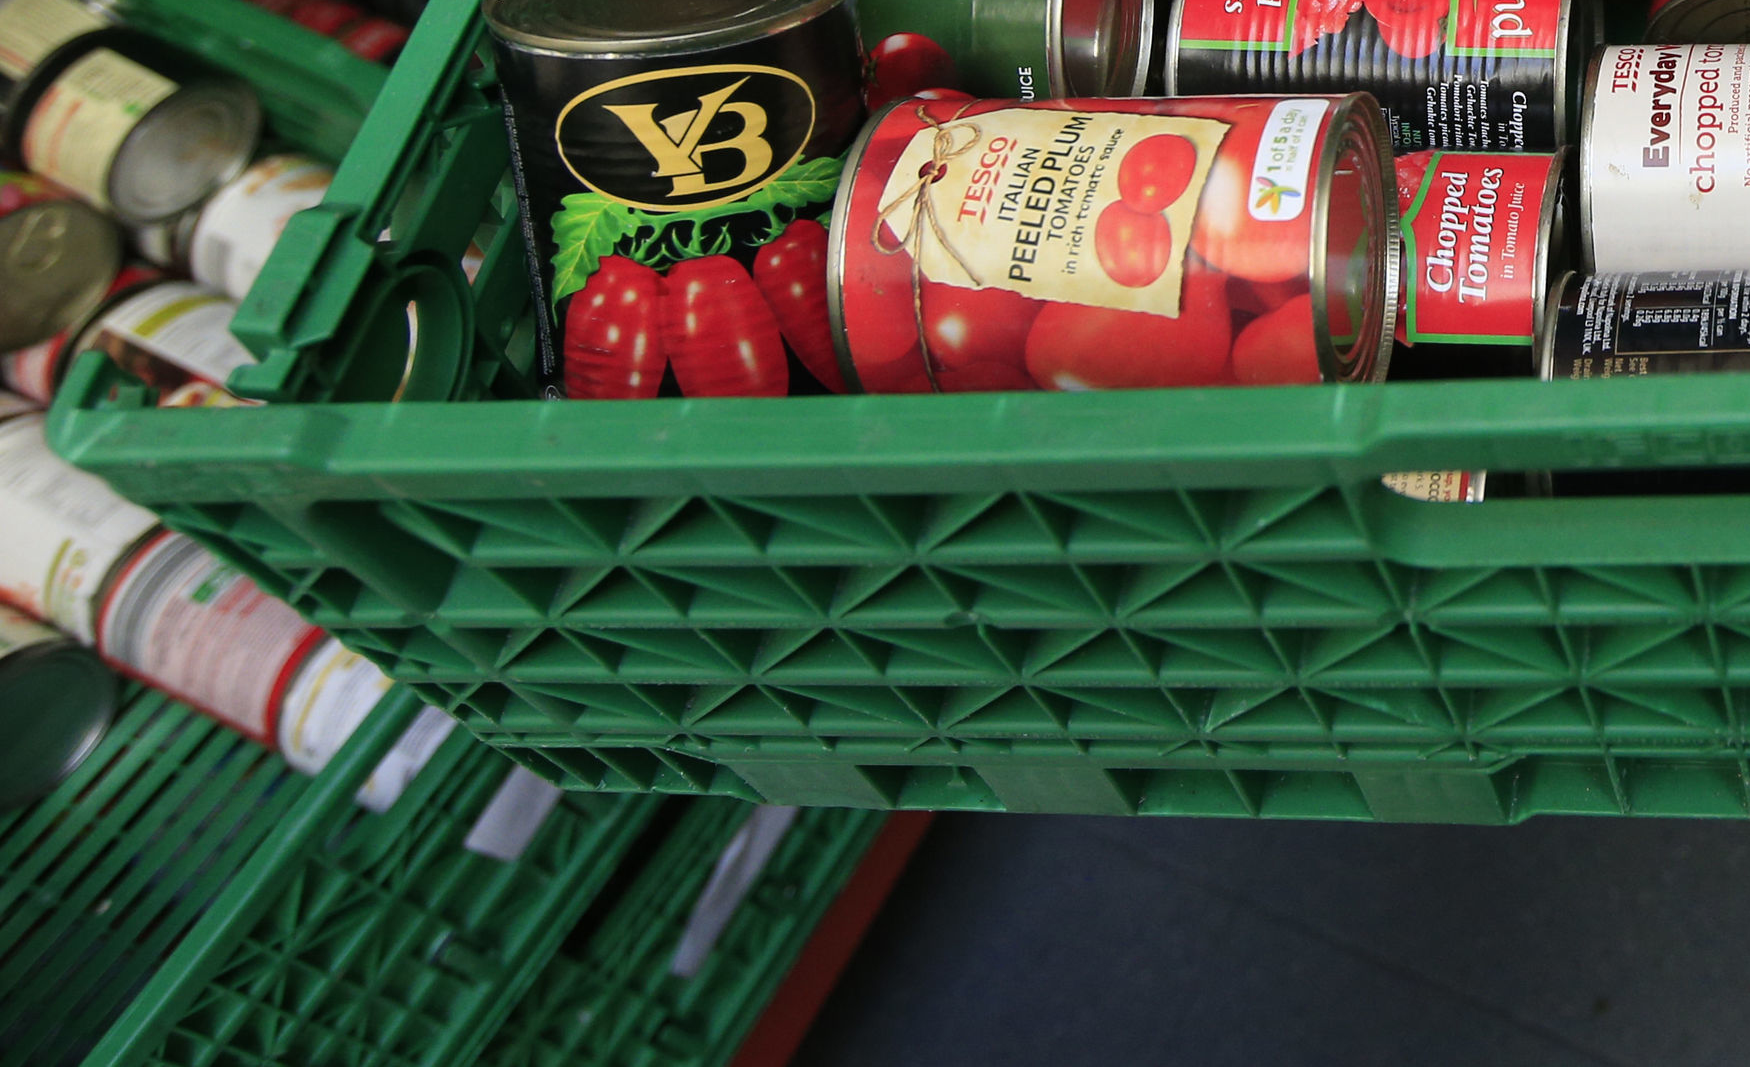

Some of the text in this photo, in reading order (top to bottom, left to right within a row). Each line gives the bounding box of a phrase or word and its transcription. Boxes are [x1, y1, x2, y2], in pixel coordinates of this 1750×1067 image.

[1453, 74, 1463, 121] Pomodori
[1611, 48, 1636, 93] TESCO
[1281, 108, 1302, 124] day
[1391, 115, 1401, 138] Typical
[1426, 87, 1437, 126] Gehakte
[1439, 82, 1450, 121] Tomates
[1466, 84, 1477, 129] Gehackte
[1479, 80, 1490, 119] Tomates
[1497, 122, 1508, 132] in
[1642, 52, 1682, 168] Everyday
[1727, 66, 1743, 134] Produced and
[1271, 148, 1285, 162] of
[1273, 136, 1288, 144] 5
[1689, 68, 1723, 193] chopped
[956, 136, 1009, 222] TESCO
[997, 148, 1041, 221] ITALIAN
[1008, 116, 1093, 283] PEELED PLUM
[1046, 146, 1095, 241] TOMATOES
[1061, 128, 1124, 274] in rich tomato sauce
[1426, 172, 1470, 292] Chopped
[1458, 167, 1504, 303] Tomatoes
[1500, 182, 1525, 279] in Tomato Juice
